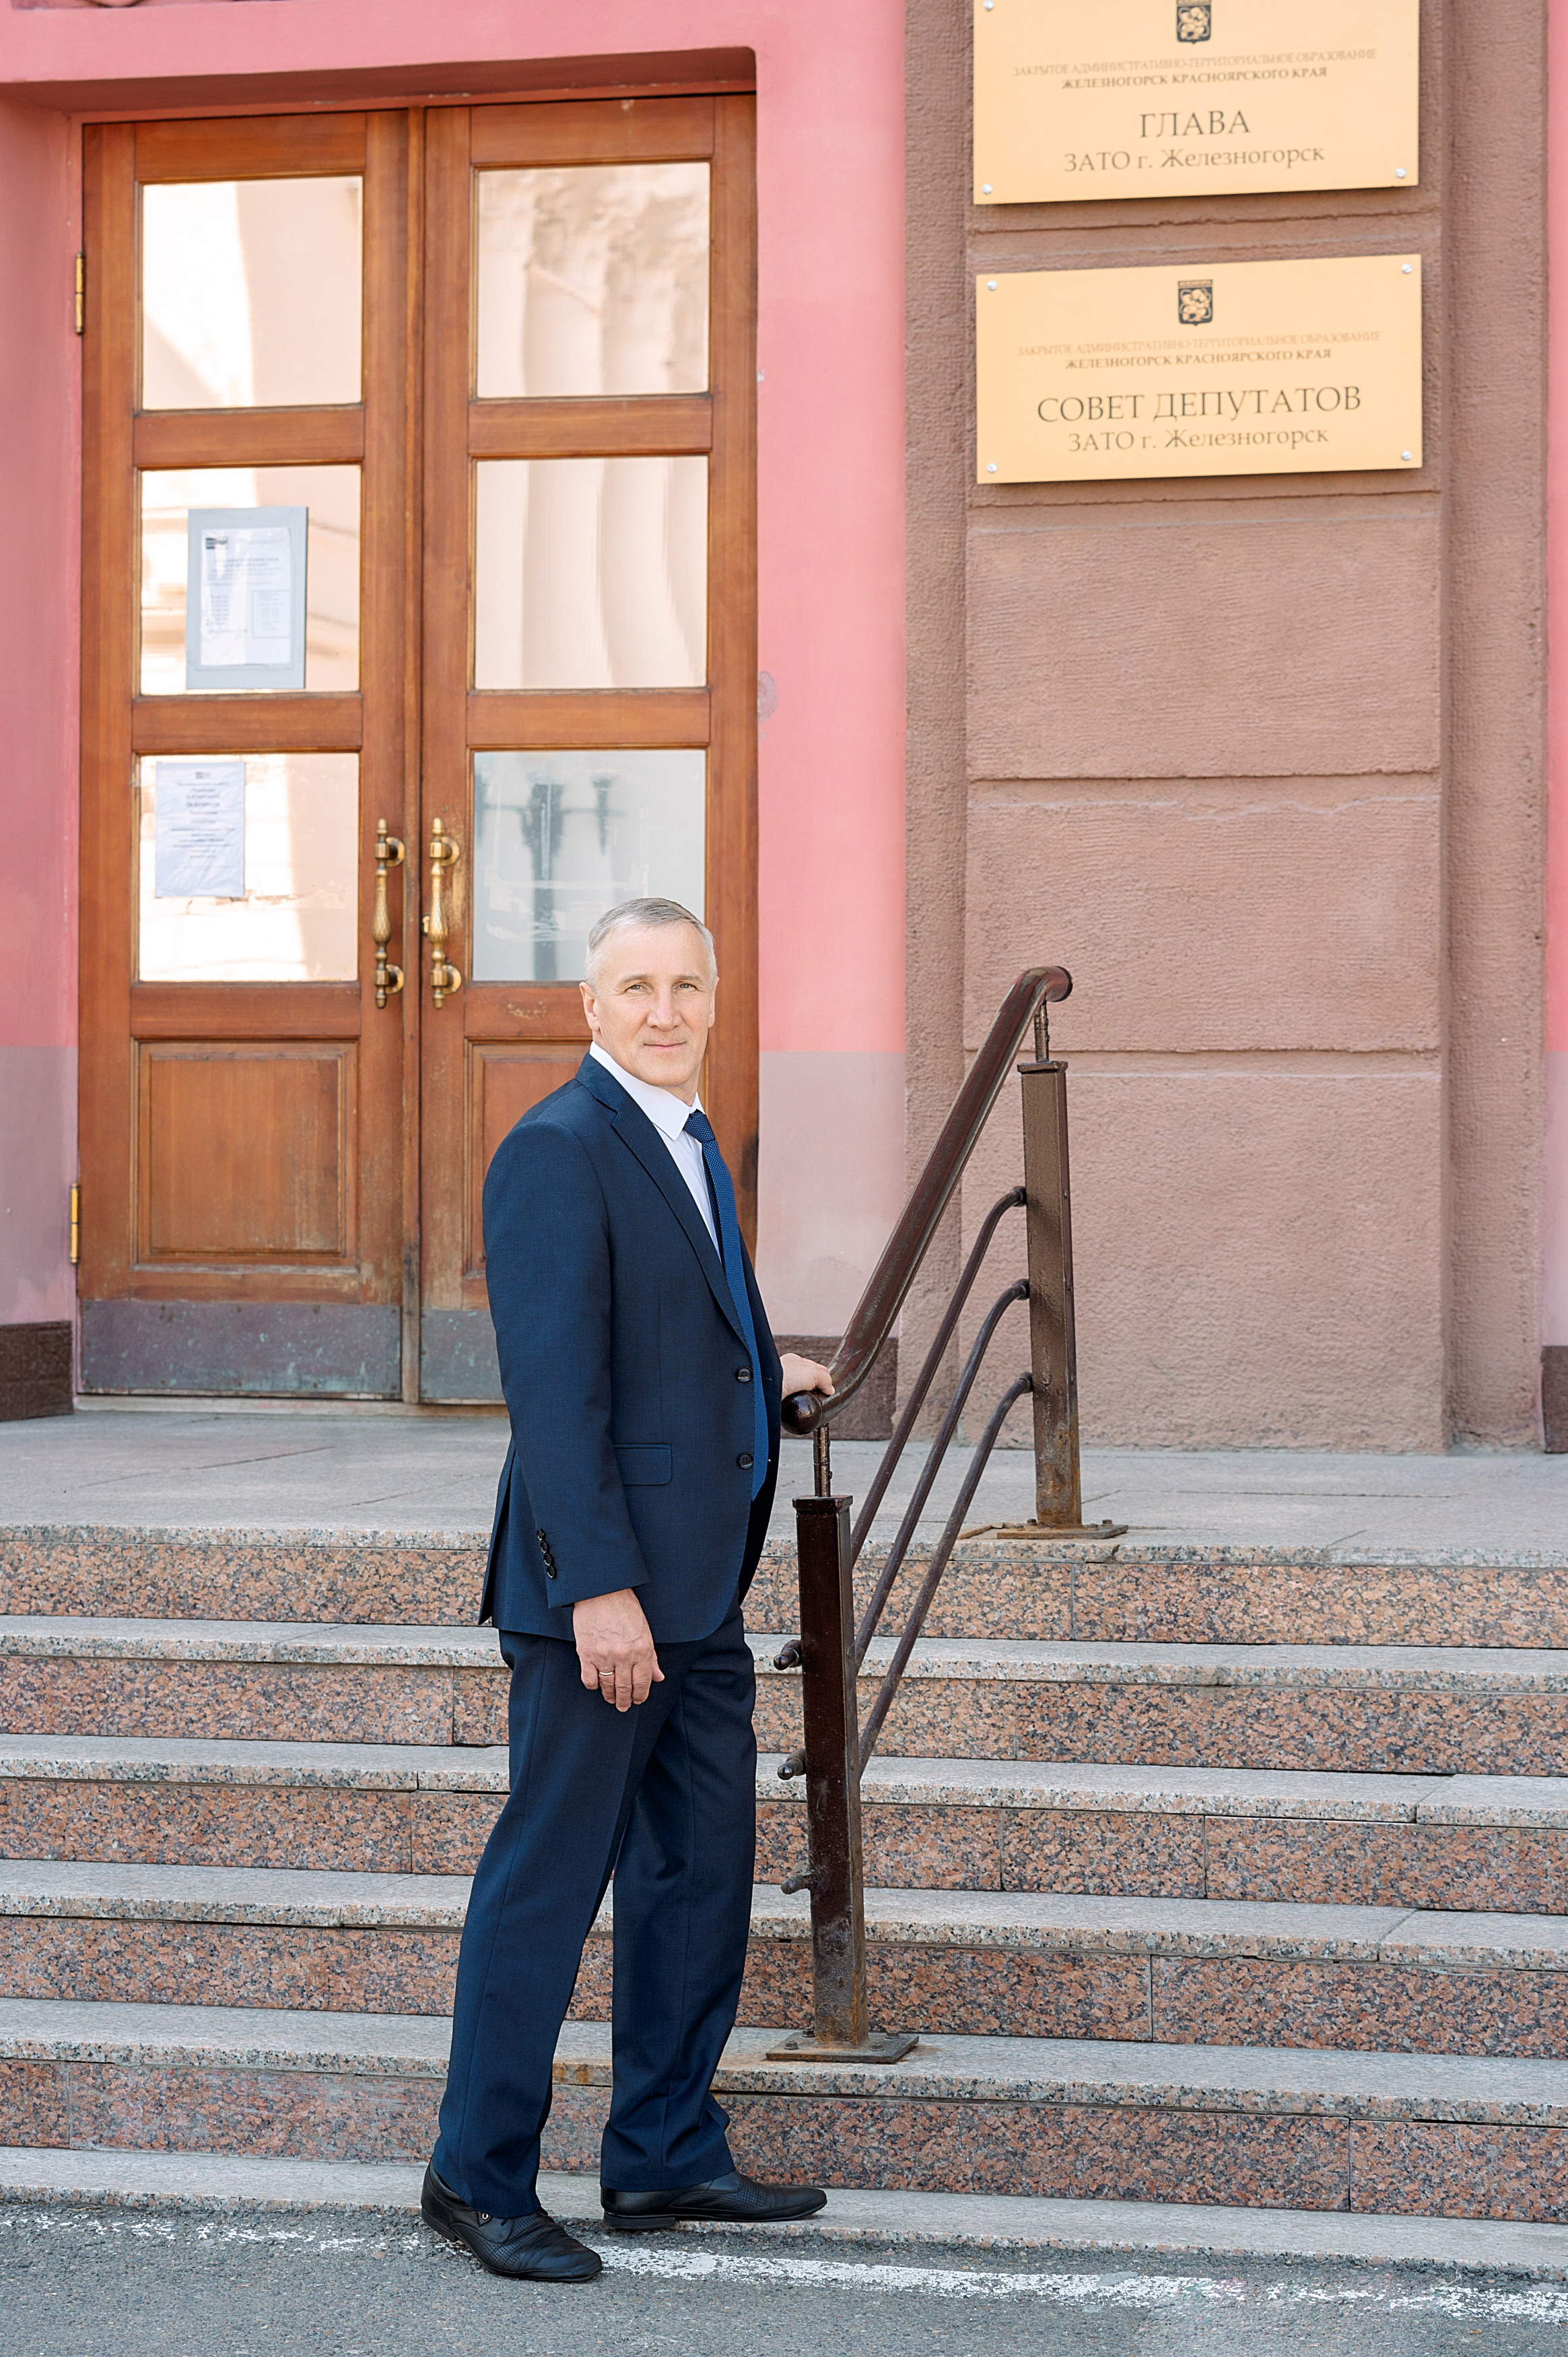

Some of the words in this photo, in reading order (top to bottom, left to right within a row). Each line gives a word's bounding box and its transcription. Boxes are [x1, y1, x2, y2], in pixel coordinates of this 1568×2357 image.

[1062, 74, 1167, 89] ЖЕЛЕЗНОГОРСК
[1172, 69, 1289, 84] КРАСНОЯРСКОГО
[1292, 67, 1327, 78] КРАЯ
[1139, 110, 1251, 138] ГЛАВА
[1064, 151, 1130, 172] ЗАТО
[1138, 156, 1153, 168] г.
[1160, 147, 1325, 168] Железногорск
[1065, 355, 1171, 370] ЖЕЛЕЗНОГОРСК
[1175, 350, 1293, 365] КРАСНОЯРСКОГО
[1296, 349, 1332, 360] КРАЯ
[1037, 395, 1145, 422] СОВЕТ
[1153, 386, 1361, 422] ДЕПУТАТОВ
[1068, 431, 1134, 452] ЗАТО
[1142, 435, 1156, 449] г.
[1165, 428, 1329, 449] Железногорск
